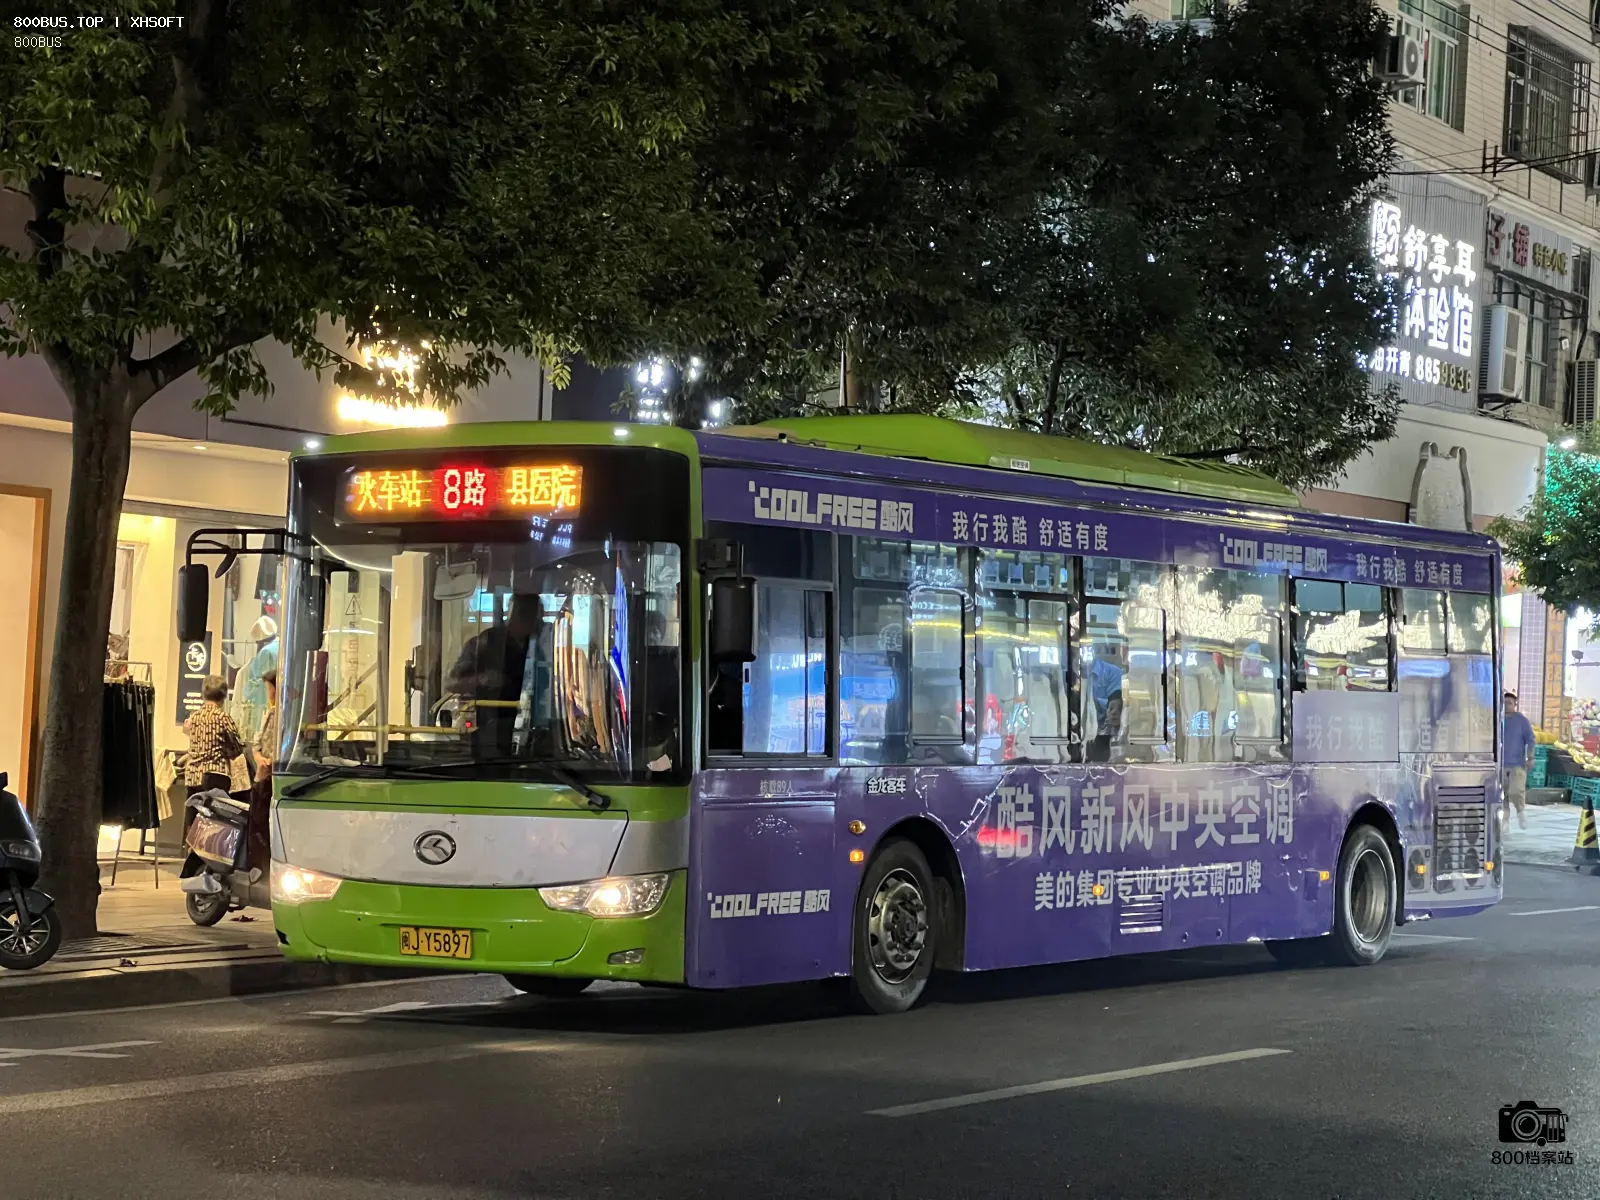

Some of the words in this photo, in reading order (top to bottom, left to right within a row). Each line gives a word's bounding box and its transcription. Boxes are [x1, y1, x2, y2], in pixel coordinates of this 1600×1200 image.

[1378, 273, 1474, 357] 体验馆
[355, 470, 422, 511] 火车站
[443, 469, 488, 510] 8路
[505, 465, 578, 508] 县医院
[749, 481, 877, 529] COOLFREE
[880, 500, 914, 534] 酷风
[952, 511, 1028, 546] 我行我酷
[1038, 517, 1109, 552] 舒适有度
[1220, 533, 1303, 571] COOLFREE
[1304, 547, 1328, 573] 酷风
[1355, 552, 1407, 583] 我行我酷
[1414, 560, 1463, 586] 舒适有度
[759, 779, 794, 794] 核载89人
[867, 776, 907, 795] 金龙客车
[996, 779, 1295, 858] 酷风新风中央空调
[707, 891, 802, 918] COOLFREE
[803, 889, 830, 913] 酷风
[1034, 860, 1262, 911] 美的集团专业中央空调品牌
